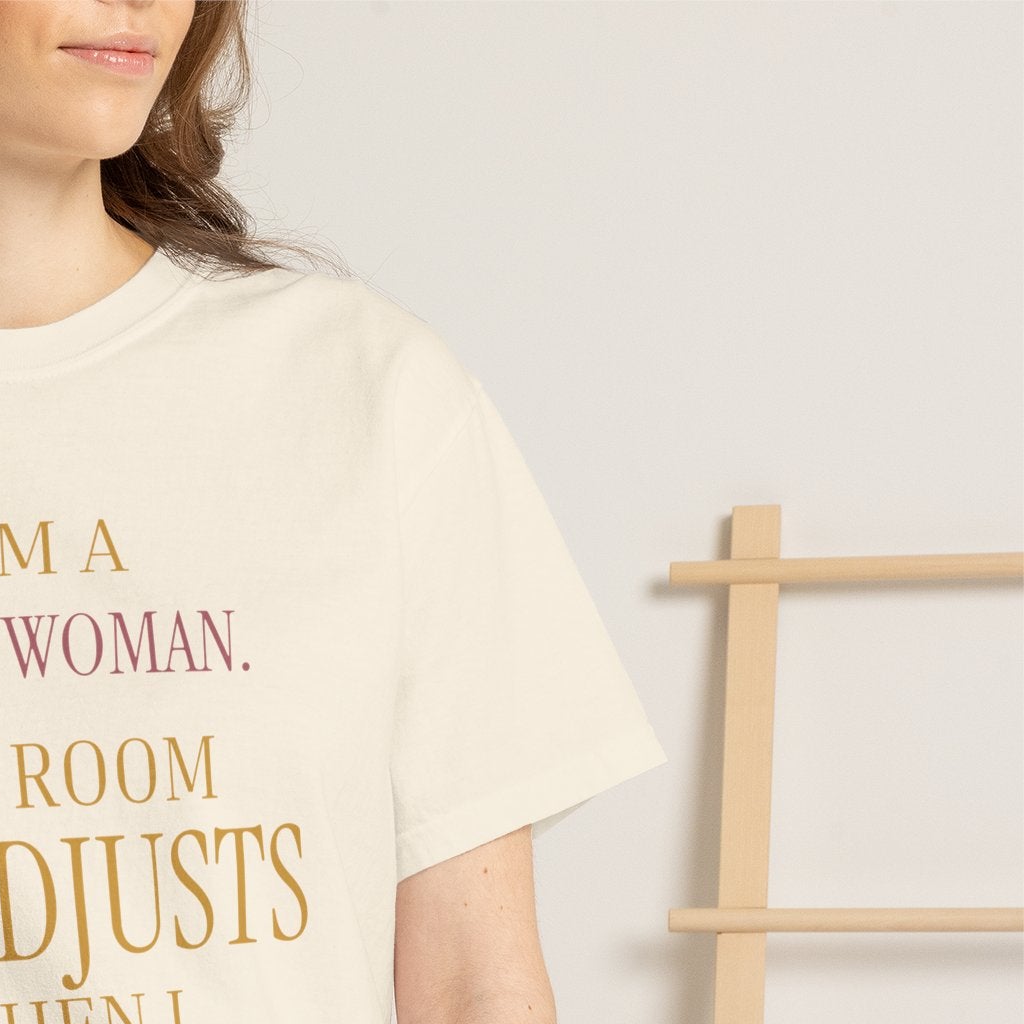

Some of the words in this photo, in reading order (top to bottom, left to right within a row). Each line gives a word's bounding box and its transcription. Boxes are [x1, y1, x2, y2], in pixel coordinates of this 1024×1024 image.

[79, 518, 129, 573] A
[0, 609, 251, 678] WOMAN.
[10, 735, 218, 809] ROOM
